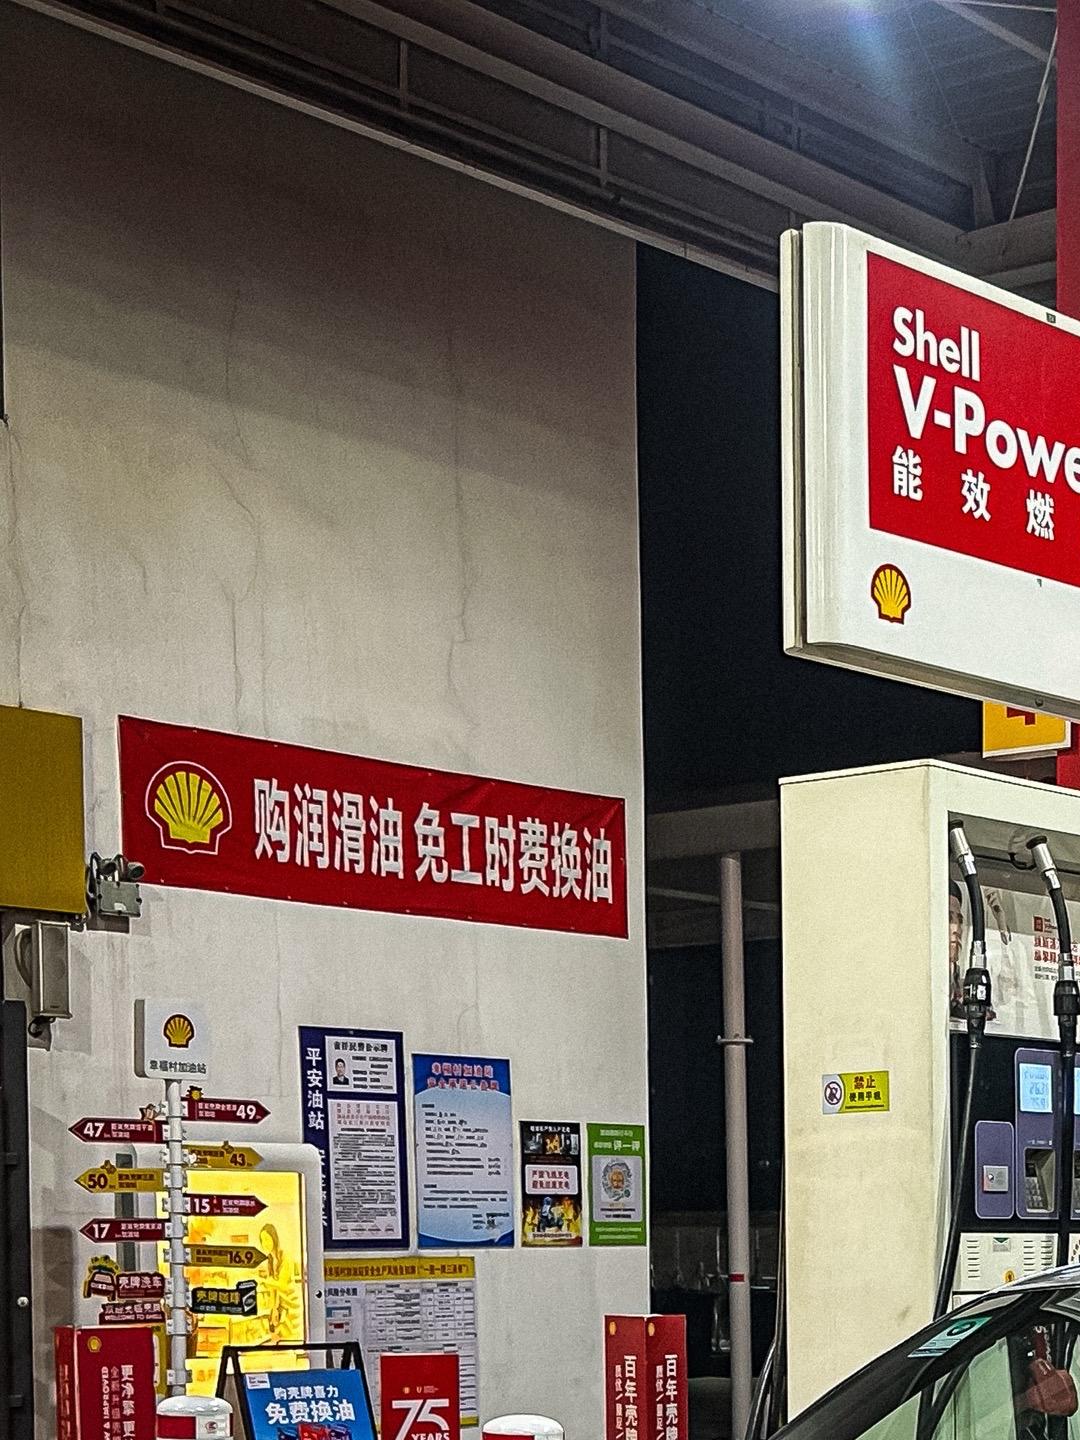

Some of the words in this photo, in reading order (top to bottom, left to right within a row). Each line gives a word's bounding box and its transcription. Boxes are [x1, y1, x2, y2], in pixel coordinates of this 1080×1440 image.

[893, 306, 980, 382] Shell
[254, 778, 404, 879] 购润滑油
[414, 803, 613, 904] 免工时费换油
[305, 1048, 325, 1130] 平安油站
[854, 1075, 876, 1089] 禁止
[236, 1105, 256, 1119] 49
[84, 1123, 105, 1137] 47
[230, 1153, 246, 1166] 43
[87, 1173, 108, 1188] 50
[194, 1199, 210, 1214] 15
[92, 1224, 110, 1238] 17
[229, 1251, 253, 1264] 16.9
[119, 1276, 162, 1288] 壳牌洗车
[273, 1385, 339, 1400] 购壳牌喜力
[265, 1399, 356, 1424] 免费换油
